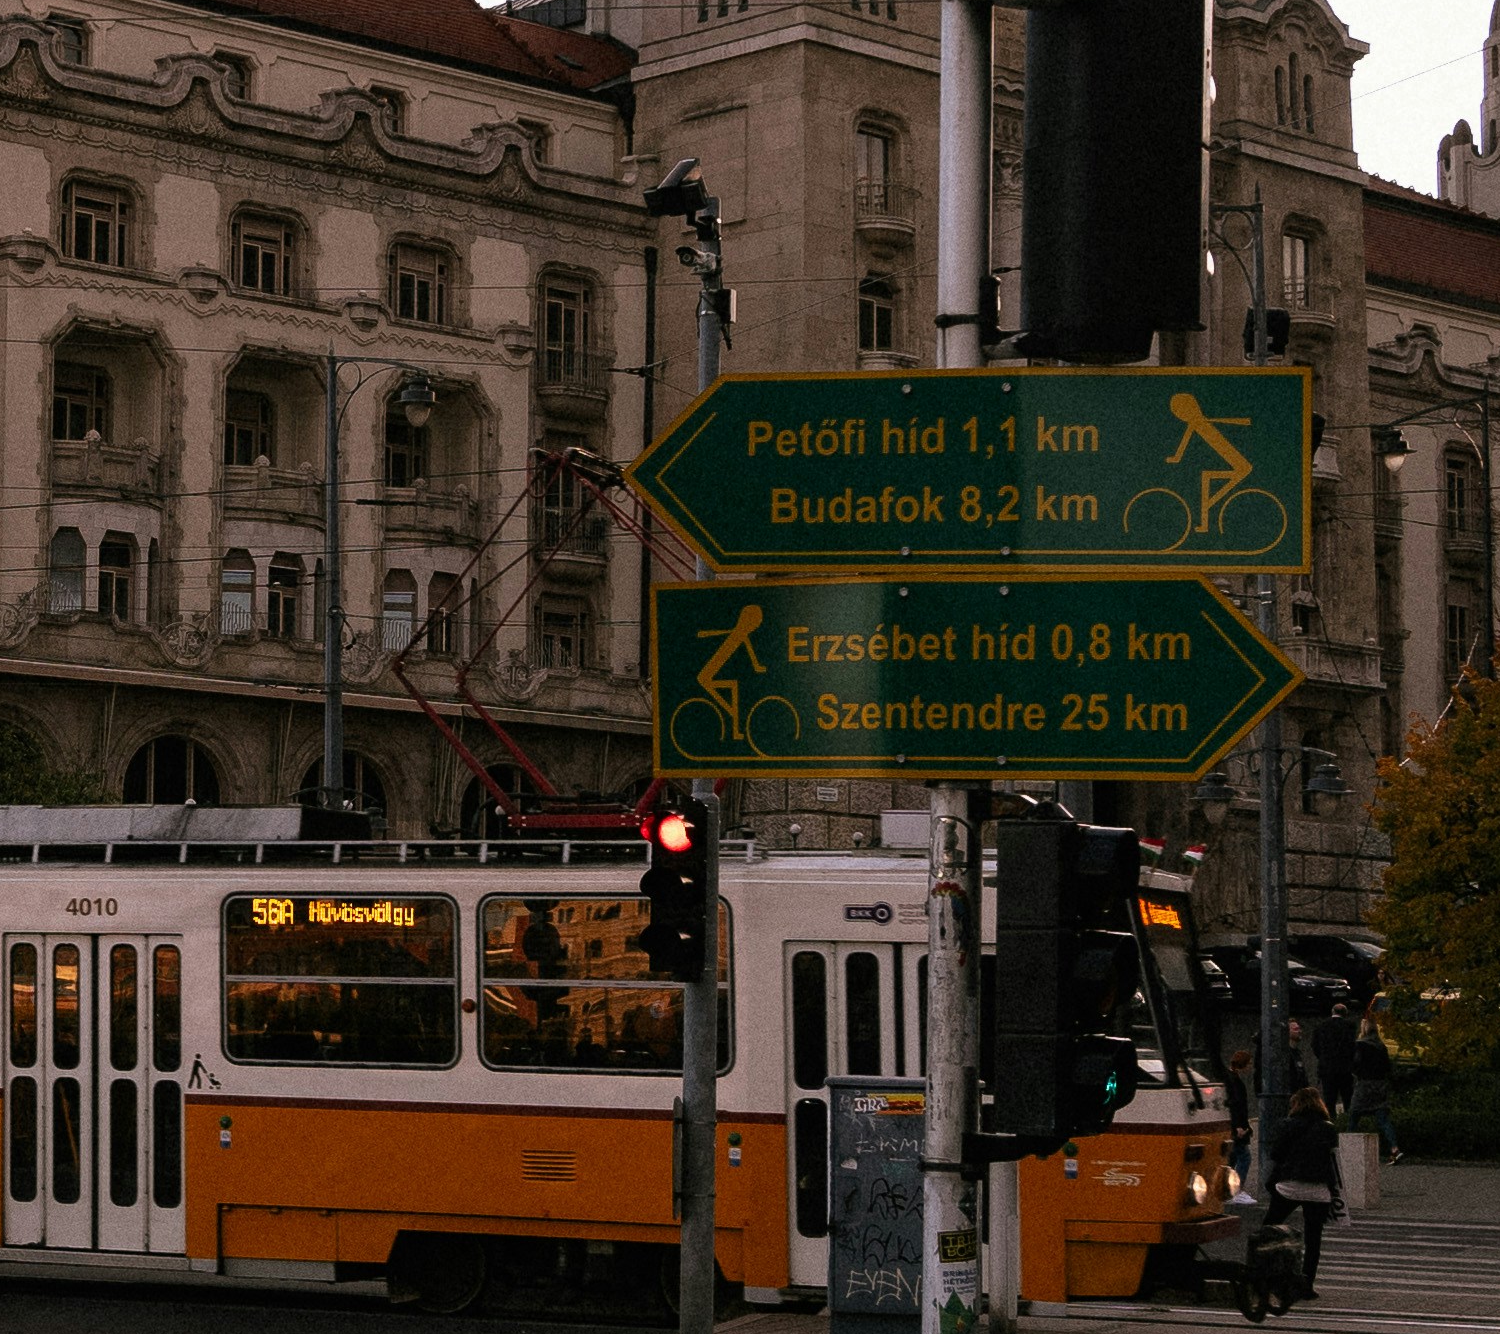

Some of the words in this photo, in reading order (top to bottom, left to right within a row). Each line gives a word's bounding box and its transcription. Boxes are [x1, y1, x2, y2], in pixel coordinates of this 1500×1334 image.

[747, 419, 866, 457] Petőfi
[881, 417, 945, 454] híd
[961, 416, 1017, 459] 1,1
[1036, 416, 1099, 452] km
[770, 487, 945, 524] Budafok
[959, 485, 1020, 528] 8,2
[1036, 485, 1099, 521] km
[787, 623, 957, 662] Erzsébet
[972, 623, 1036, 660] híd
[1050, 623, 1111, 667] 0,8
[1128, 623, 1191, 660] km
[816, 693, 1046, 730] Szentendre
[1060, 693, 1109, 730] 25
[1125, 693, 1188, 730] km
[65, 897, 118, 916] 4010
[252, 898, 295, 925] 56A
